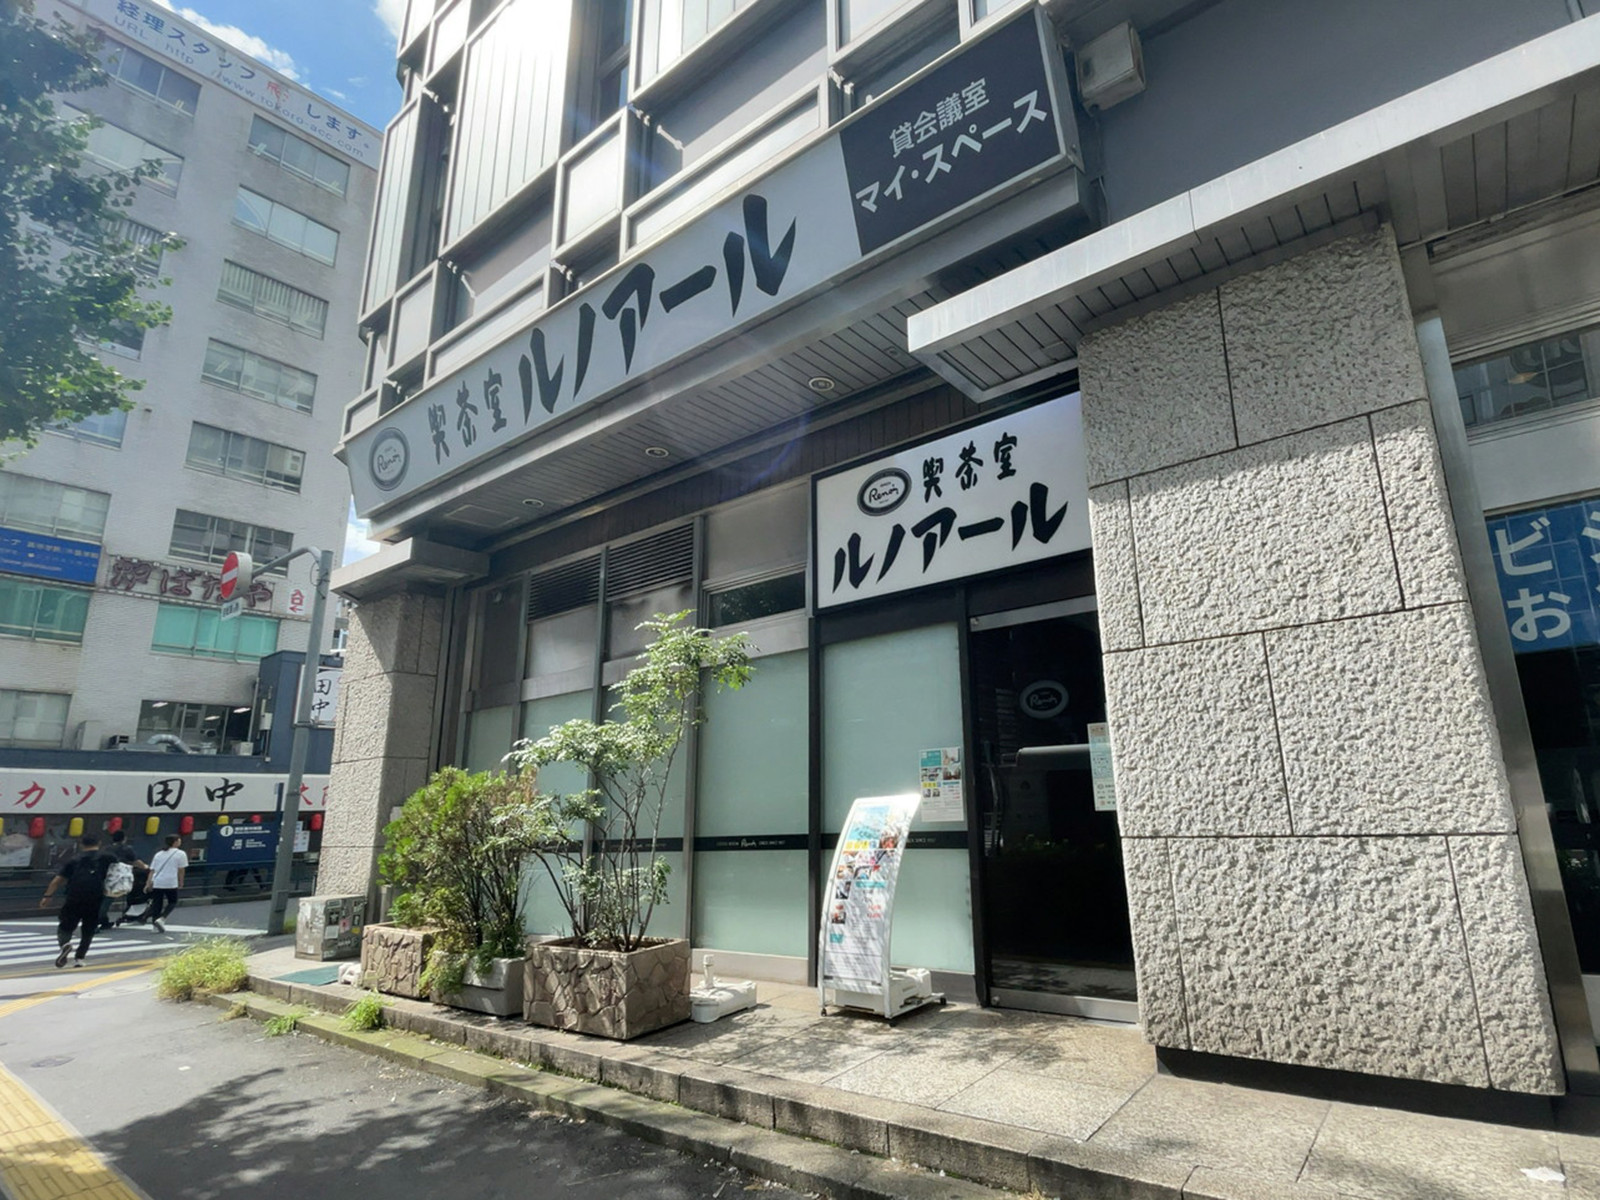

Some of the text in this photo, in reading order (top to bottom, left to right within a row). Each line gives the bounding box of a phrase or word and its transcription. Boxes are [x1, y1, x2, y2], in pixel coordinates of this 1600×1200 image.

[855, 89, 1048, 214] マイ・スペース
[889, 77, 990, 159] 貸会議室
[427, 193, 797, 466] 喫茶室 ルノアール
[922, 431, 1018, 504] 喫茶室
[832, 481, 1069, 595] ルノアール
[1494, 510, 1600, 577] ビ
[0, 780, 97, 809] カツ
[146, 777, 245, 811] 田中
